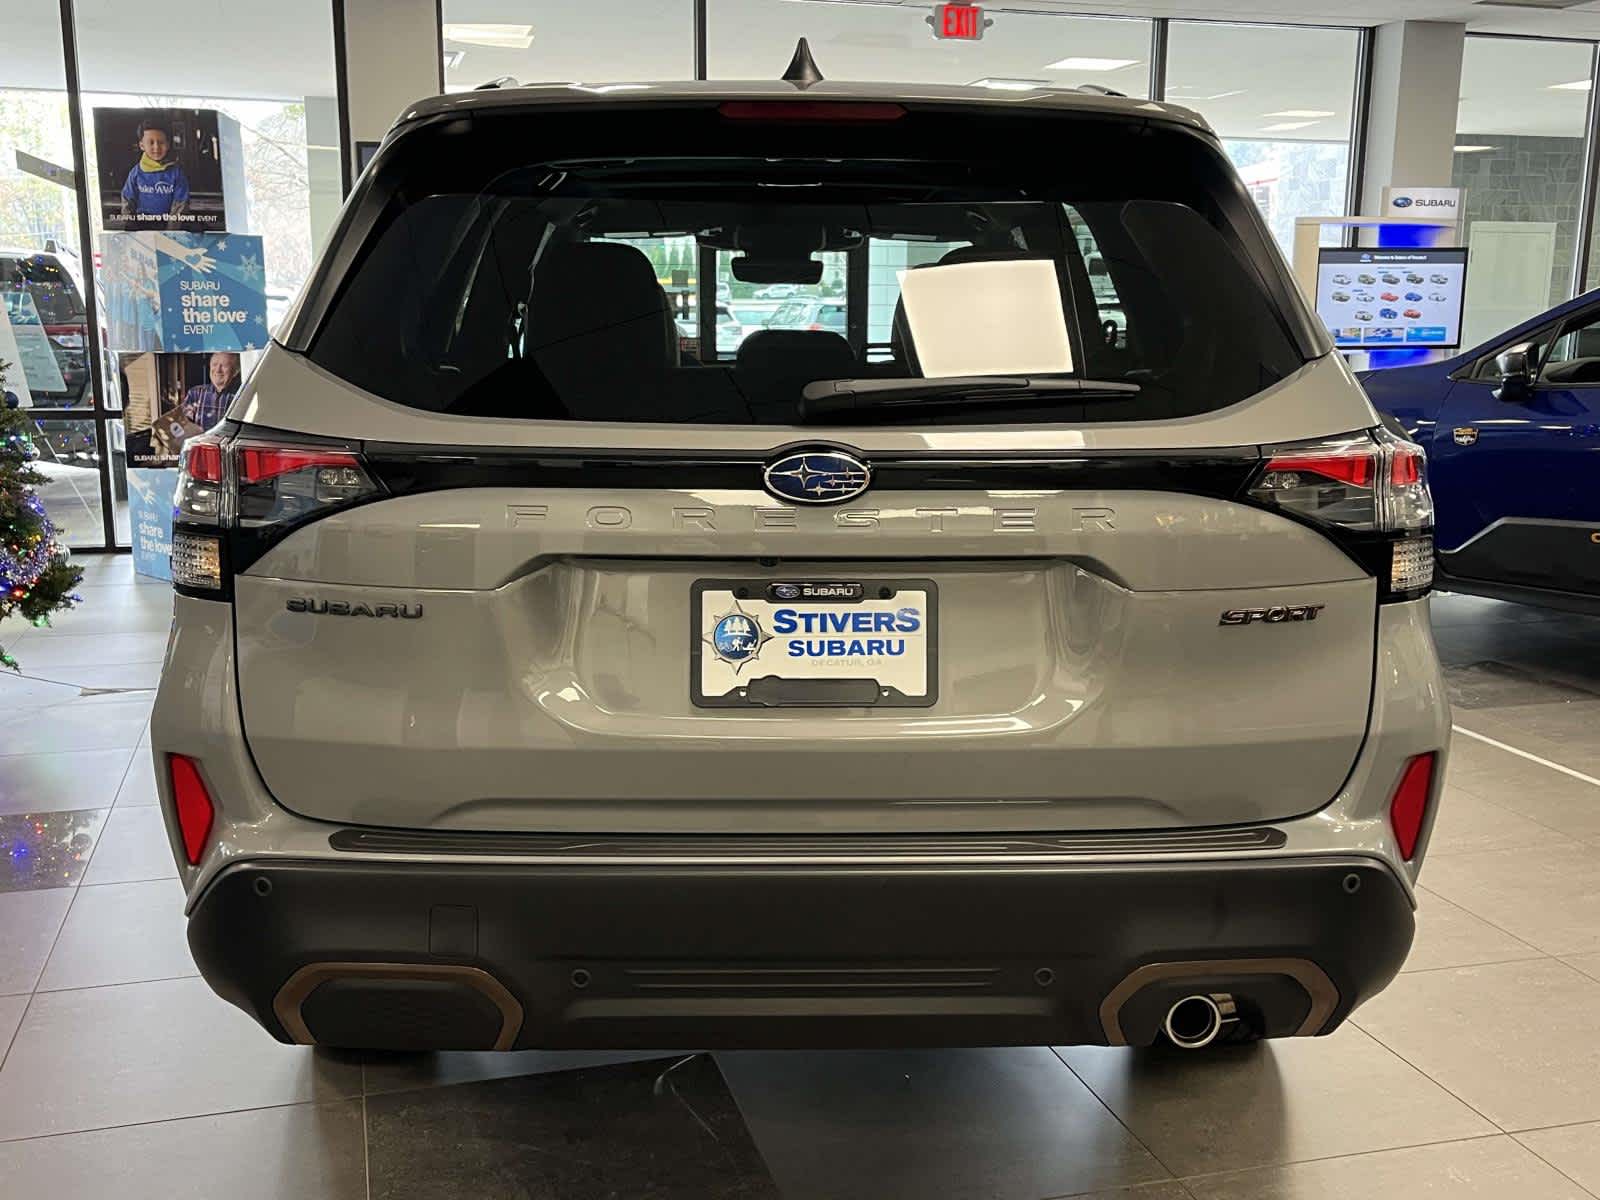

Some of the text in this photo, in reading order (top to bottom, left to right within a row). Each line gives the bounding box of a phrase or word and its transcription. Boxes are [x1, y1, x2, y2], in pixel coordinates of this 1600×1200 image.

[943, 6, 978, 38] EXIT
[1415, 199, 1456, 208] SUBARU
[137, 213, 162, 221] share
[163, 213, 177, 221] the
[178, 213, 195, 222] love
[180, 281, 220, 290] SUBARU
[181, 292, 230, 307] share
[183, 308, 246, 323] the love
[183, 324, 214, 335] EVENT
[505, 504, 1117, 532] FORESTER
[138, 521, 164, 538] share
[140, 535, 154, 552] the
[803, 587, 854, 597] SUBARU
[286, 598, 423, 619] SUBARU
[1219, 601, 1326, 626] SPORT
[788, 639, 905, 657] SUBARU
